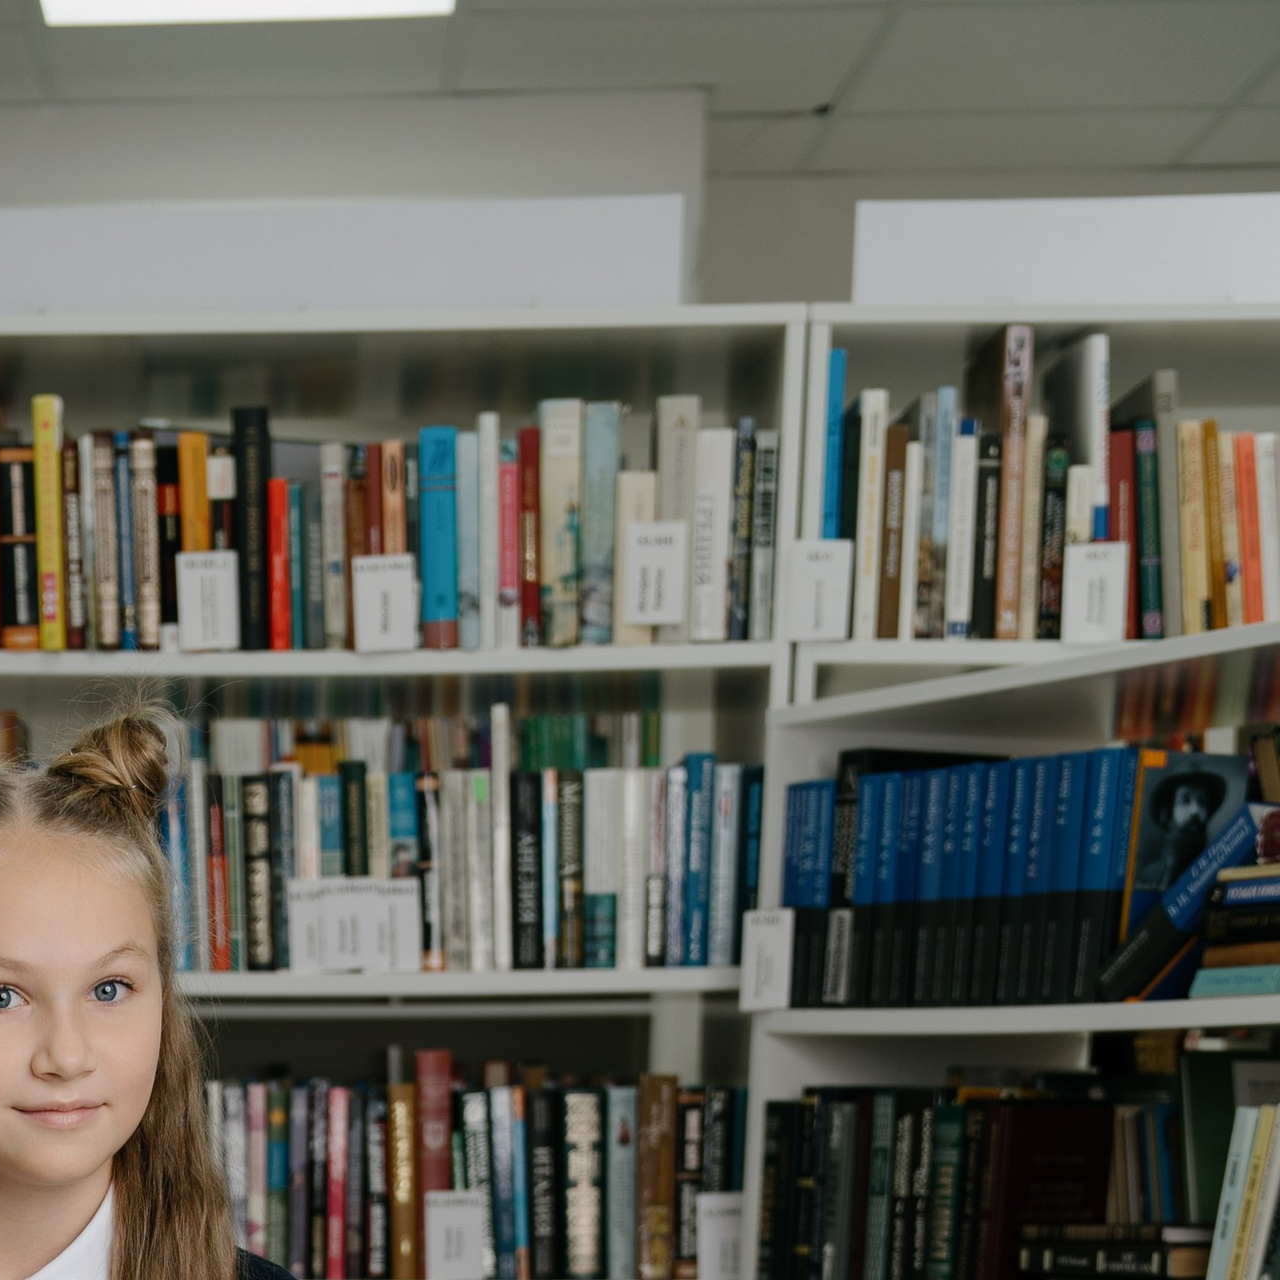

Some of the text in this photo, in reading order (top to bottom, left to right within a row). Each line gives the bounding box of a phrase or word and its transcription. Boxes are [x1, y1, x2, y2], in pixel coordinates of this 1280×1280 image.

[695, 495, 715, 585] ГРЕЦИЯ
[517, 831, 538, 924] АНГЛИЯ
[533, 1147, 555, 1238] ИТАЛИЯ
